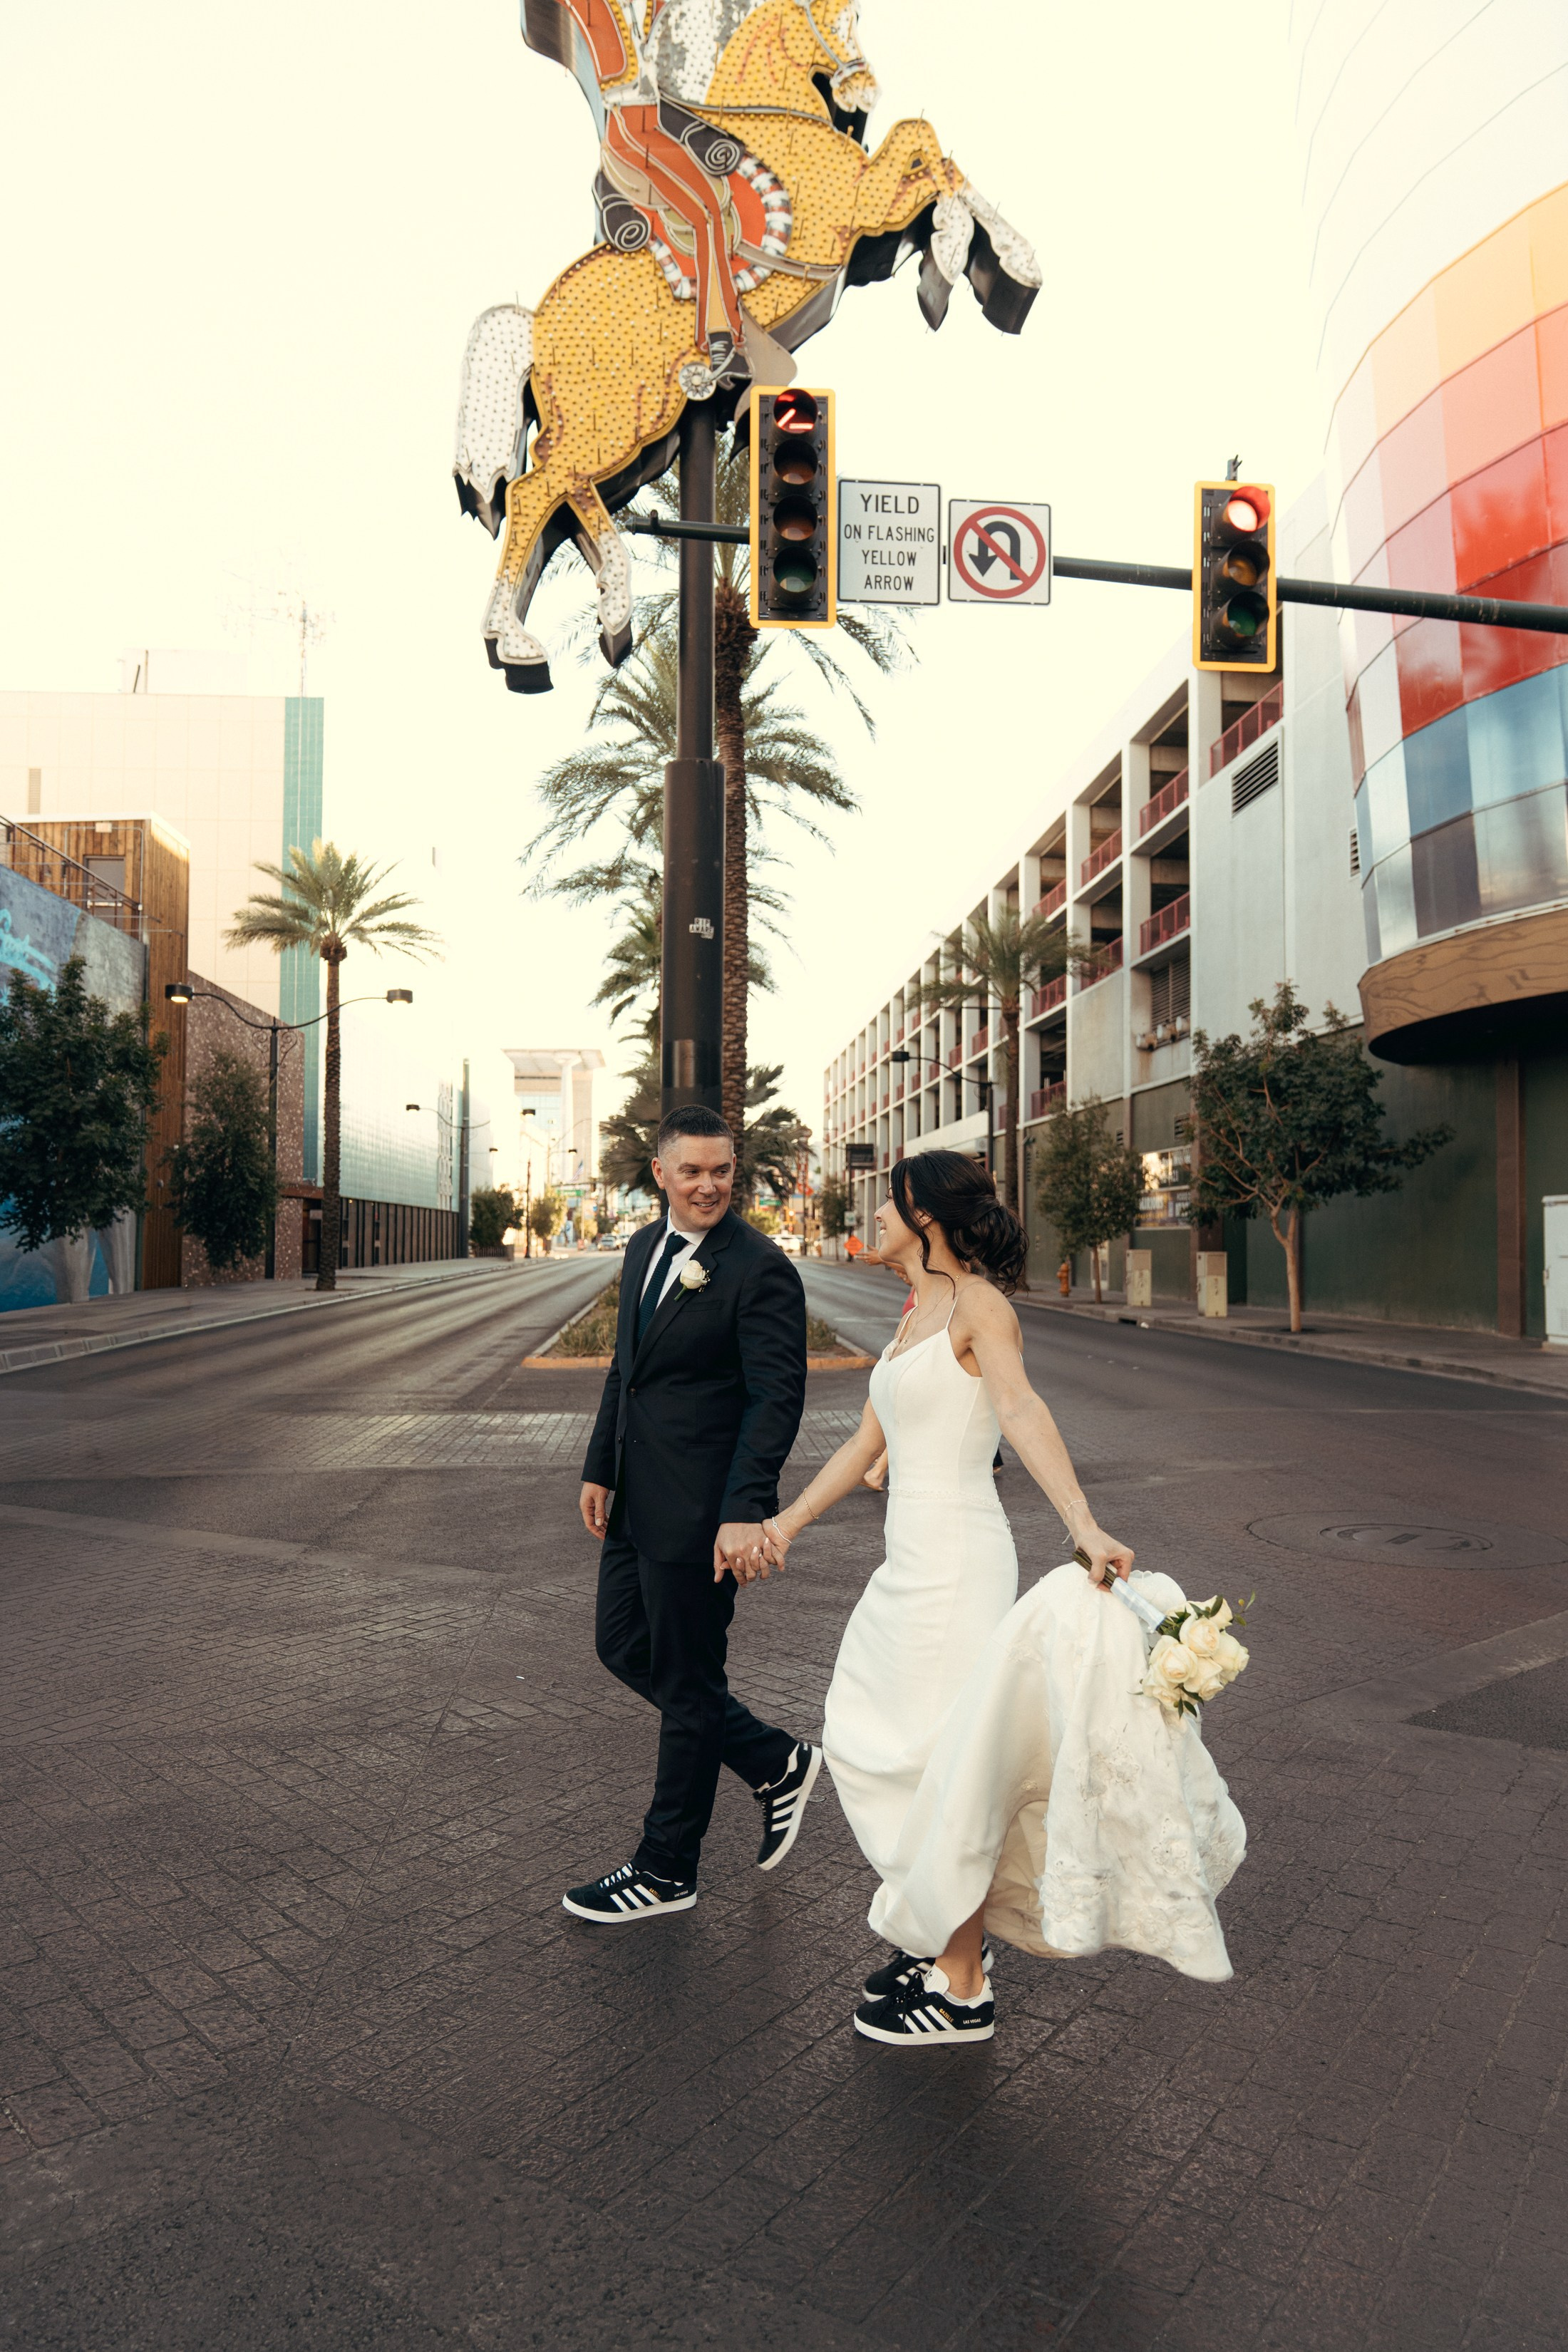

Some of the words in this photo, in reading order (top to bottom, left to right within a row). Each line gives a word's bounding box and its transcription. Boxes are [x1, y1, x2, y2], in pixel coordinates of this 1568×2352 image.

[860, 493, 919, 514] YIELD
[844, 524, 861, 539] ON
[868, 525, 934, 542] FLASHING
[862, 550, 917, 566] YELLOW
[864, 574, 914, 591] ARROW
[939, 2008, 954, 2023] GAZELLE
